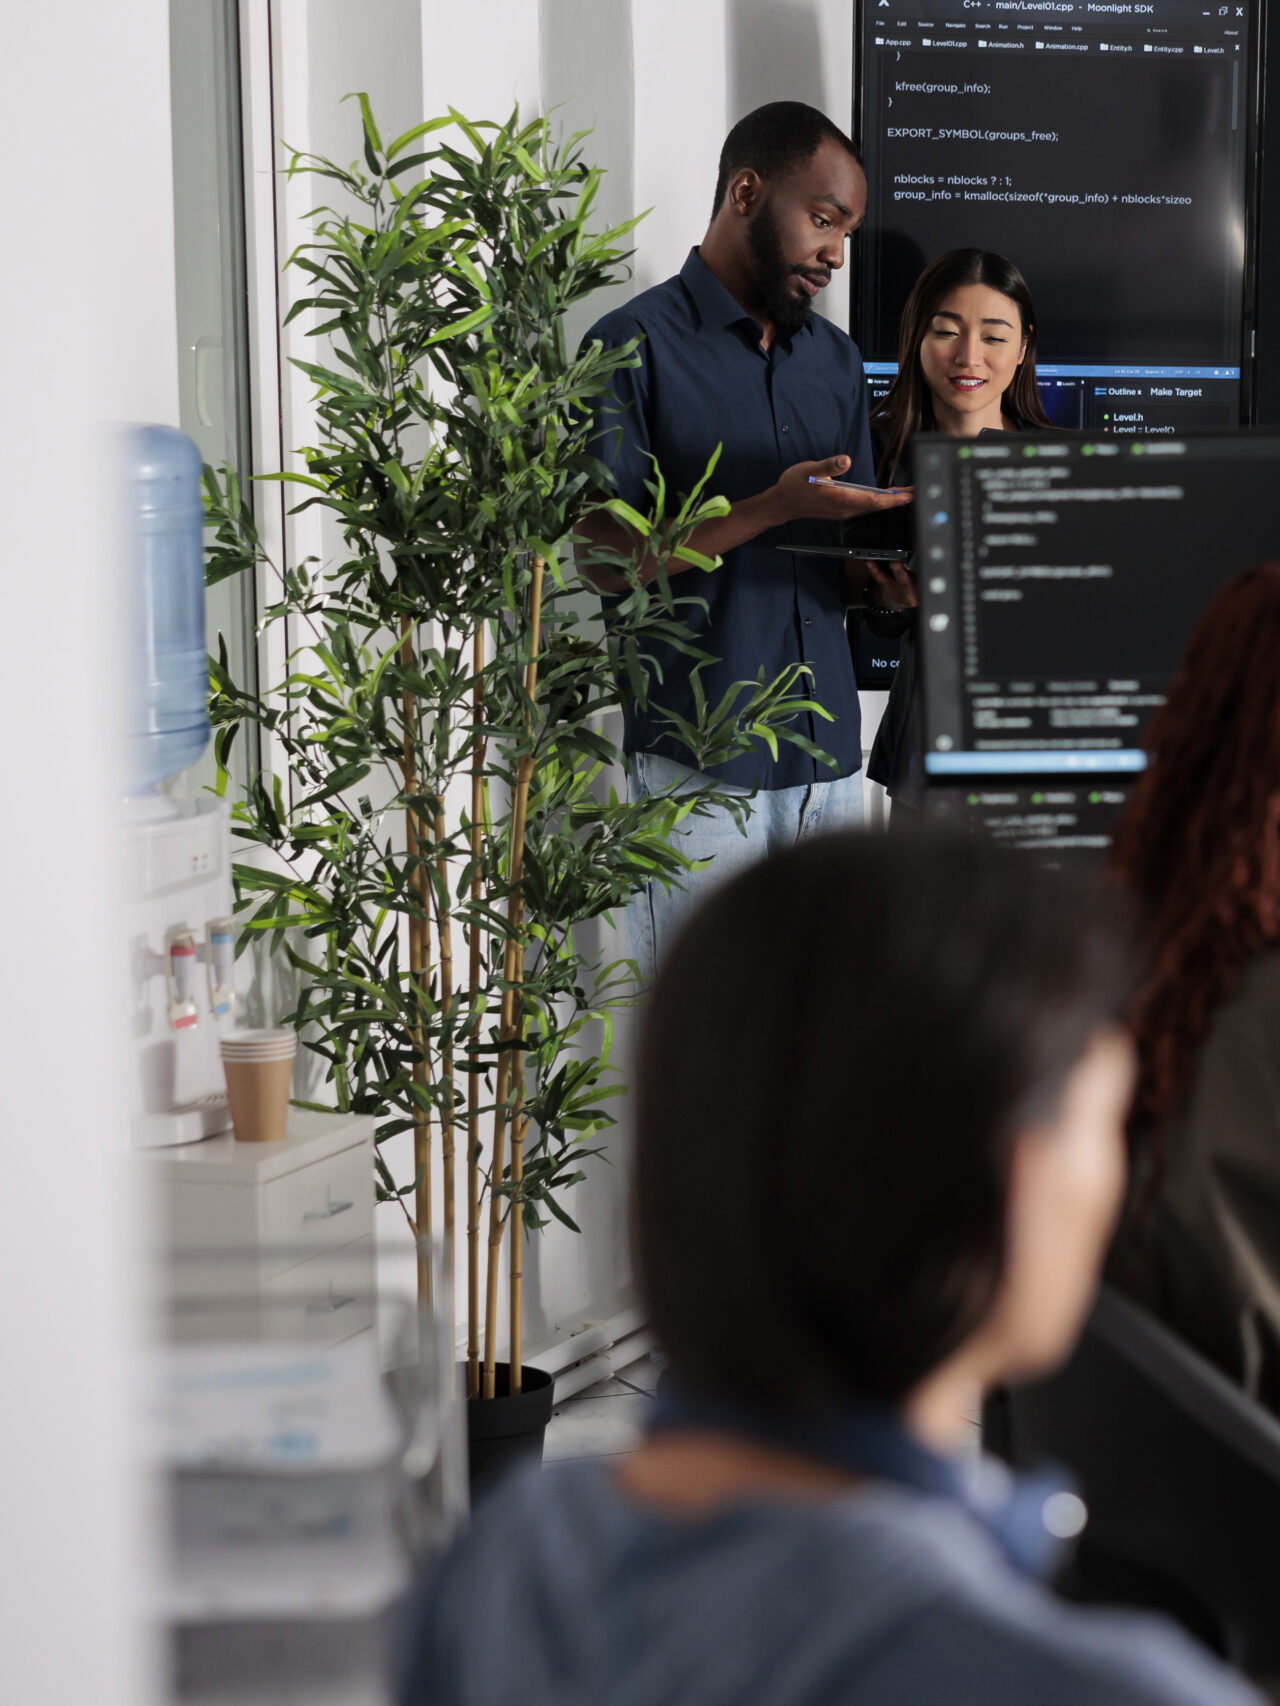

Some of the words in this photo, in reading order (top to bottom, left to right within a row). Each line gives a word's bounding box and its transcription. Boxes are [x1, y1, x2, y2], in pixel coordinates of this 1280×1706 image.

[962, 0, 982, 8] C++
[996, 0, 1074, 12] main/Level01.cpp
[1088, 2, 1132, 14] Moonlight
[1134, 4, 1154, 14] SDK
[1046, 42, 1088, 52] Animation.cpp
[896, 82, 990, 94] kfree(group_info);
[888, 128, 1058, 142] EXPORT_SYMBOL(groups_free);
[894, 174, 934, 184] nblocks
[948, 176, 988, 186] nblocks
[990, 176, 996, 186] ?
[894, 190, 952, 202] group_info
[1108, 388, 1136, 396] Outline
[1150, 388, 1172, 396] Make
[1174, 388, 1202, 398] Target
[1114, 412, 1144, 422] Level.h
[1114, 426, 1136, 434] Level
[872, 658, 888, 668] No
